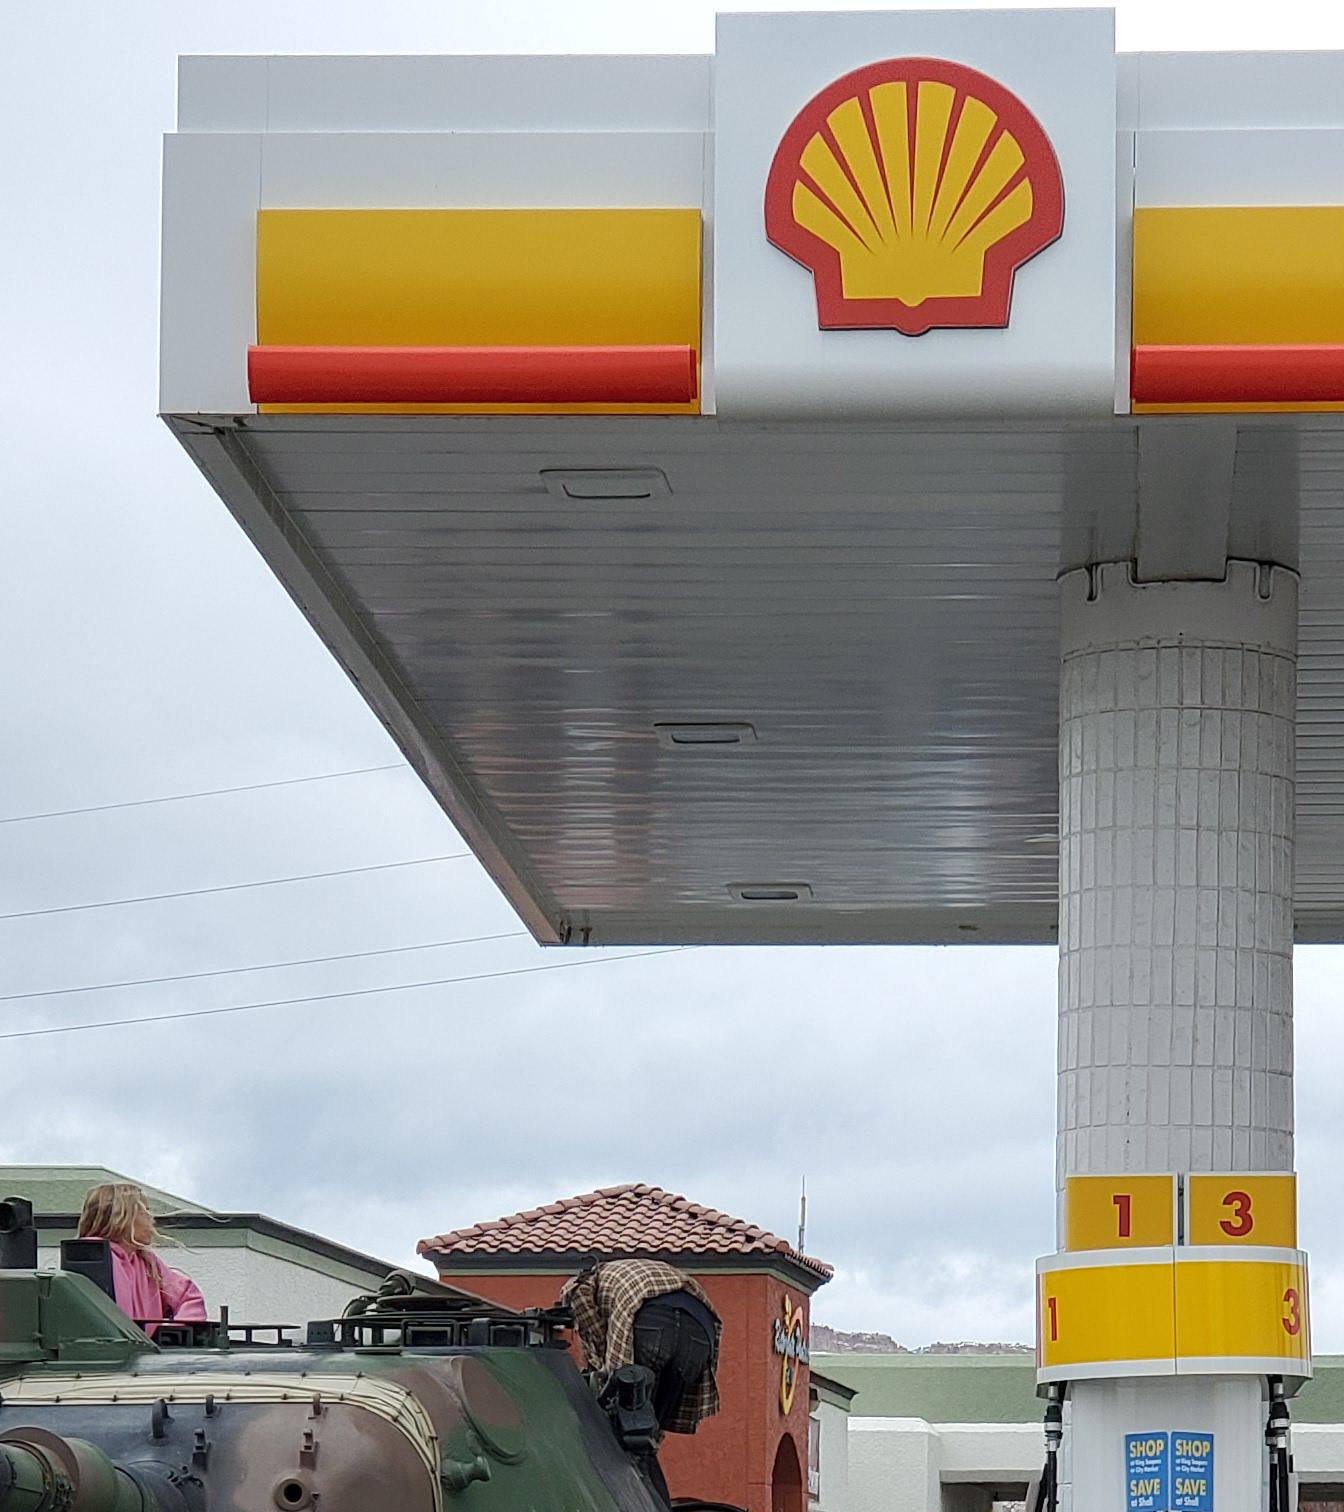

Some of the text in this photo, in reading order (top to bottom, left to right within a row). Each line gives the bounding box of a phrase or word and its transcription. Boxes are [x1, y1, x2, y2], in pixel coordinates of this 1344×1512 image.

[1112, 1194, 1131, 1238] 1
[1219, 1191, 1254, 1237] 3
[1047, 1297, 1057, 1341] 1
[1282, 1288, 1300, 1336] 3
[1130, 1440, 1164, 1457] SHOP
[1176, 1440, 1210, 1457] SHOP
[1130, 1479, 1160, 1496] SAVE
[1176, 1478, 1206, 1496] SAVE
[1131, 1499, 1137, 1507] at
[1176, 1497, 1183, 1506] at
